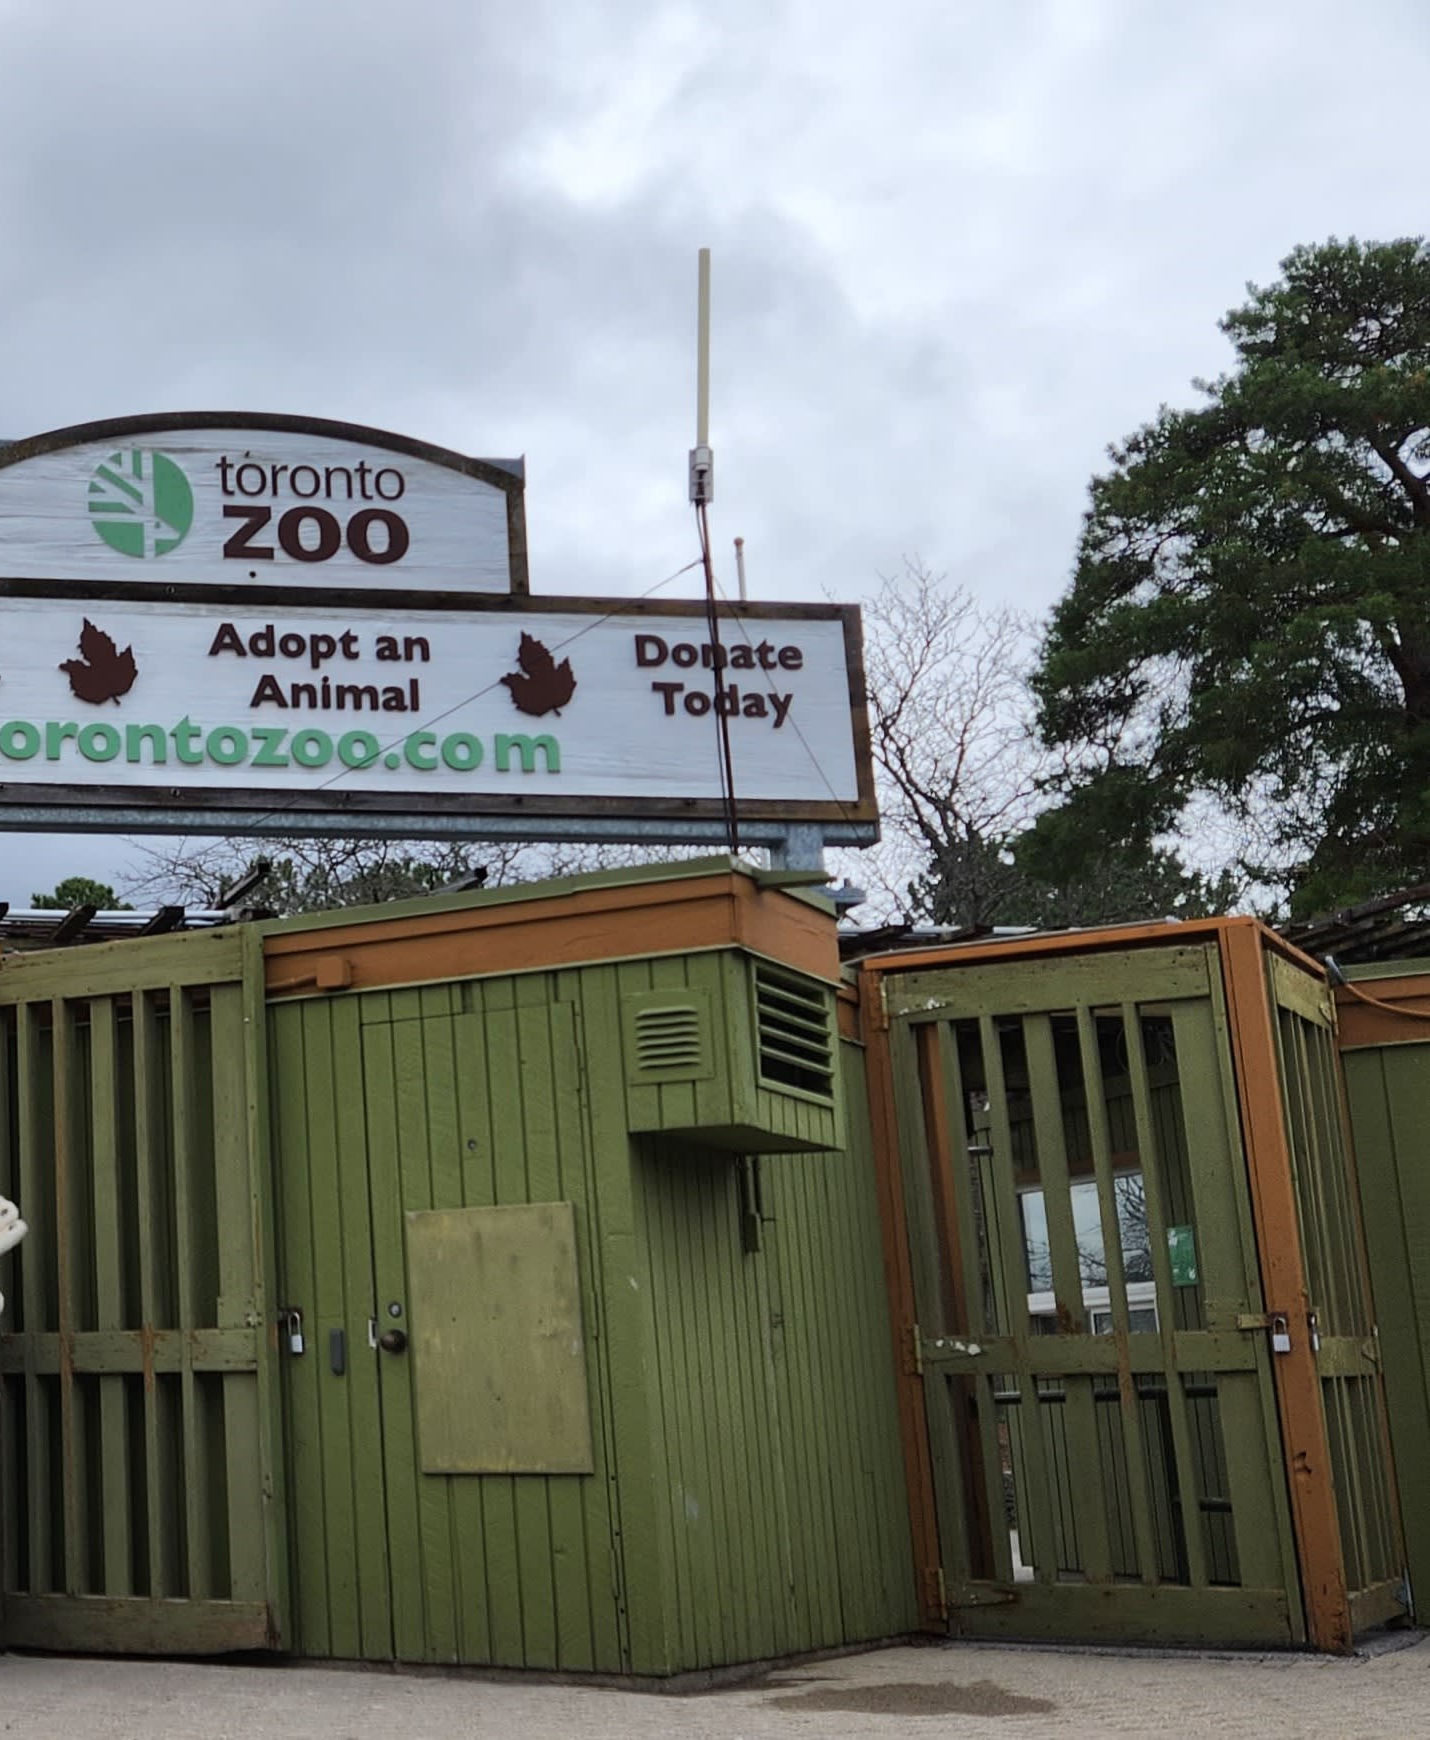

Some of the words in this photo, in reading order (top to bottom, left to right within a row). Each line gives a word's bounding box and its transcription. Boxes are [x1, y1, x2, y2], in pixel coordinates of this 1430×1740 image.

[215, 455, 406, 502] toronto
[208, 622, 360, 671] Adopt
[375, 635, 431, 663] an
[634, 634, 804, 672] Donate
[249, 674, 420, 713] Animal
[651, 681, 795, 729] Today
